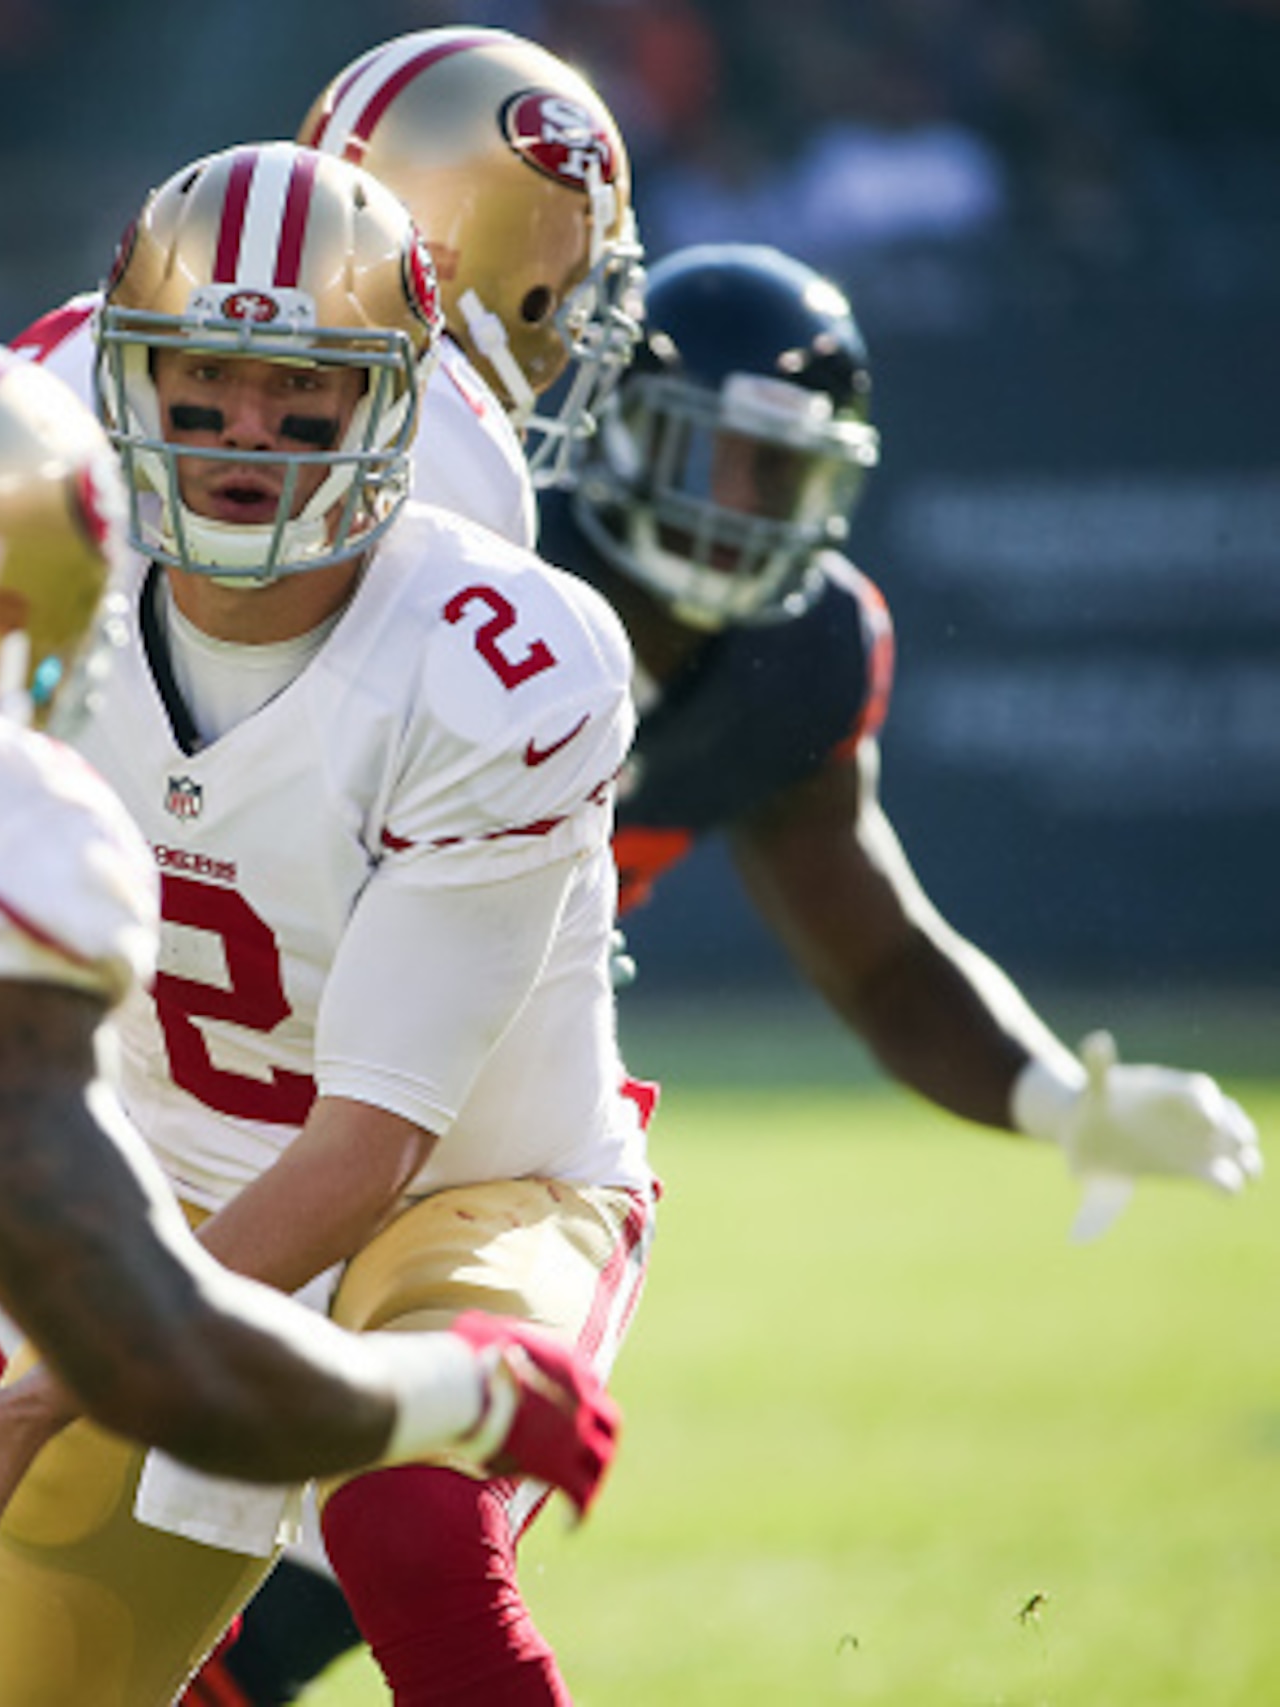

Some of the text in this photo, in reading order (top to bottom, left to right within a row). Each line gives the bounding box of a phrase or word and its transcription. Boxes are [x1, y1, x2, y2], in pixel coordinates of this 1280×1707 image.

[441, 583, 558, 691] 2
[147, 841, 237, 882] 9ERS
[150, 873, 320, 1127] 2
